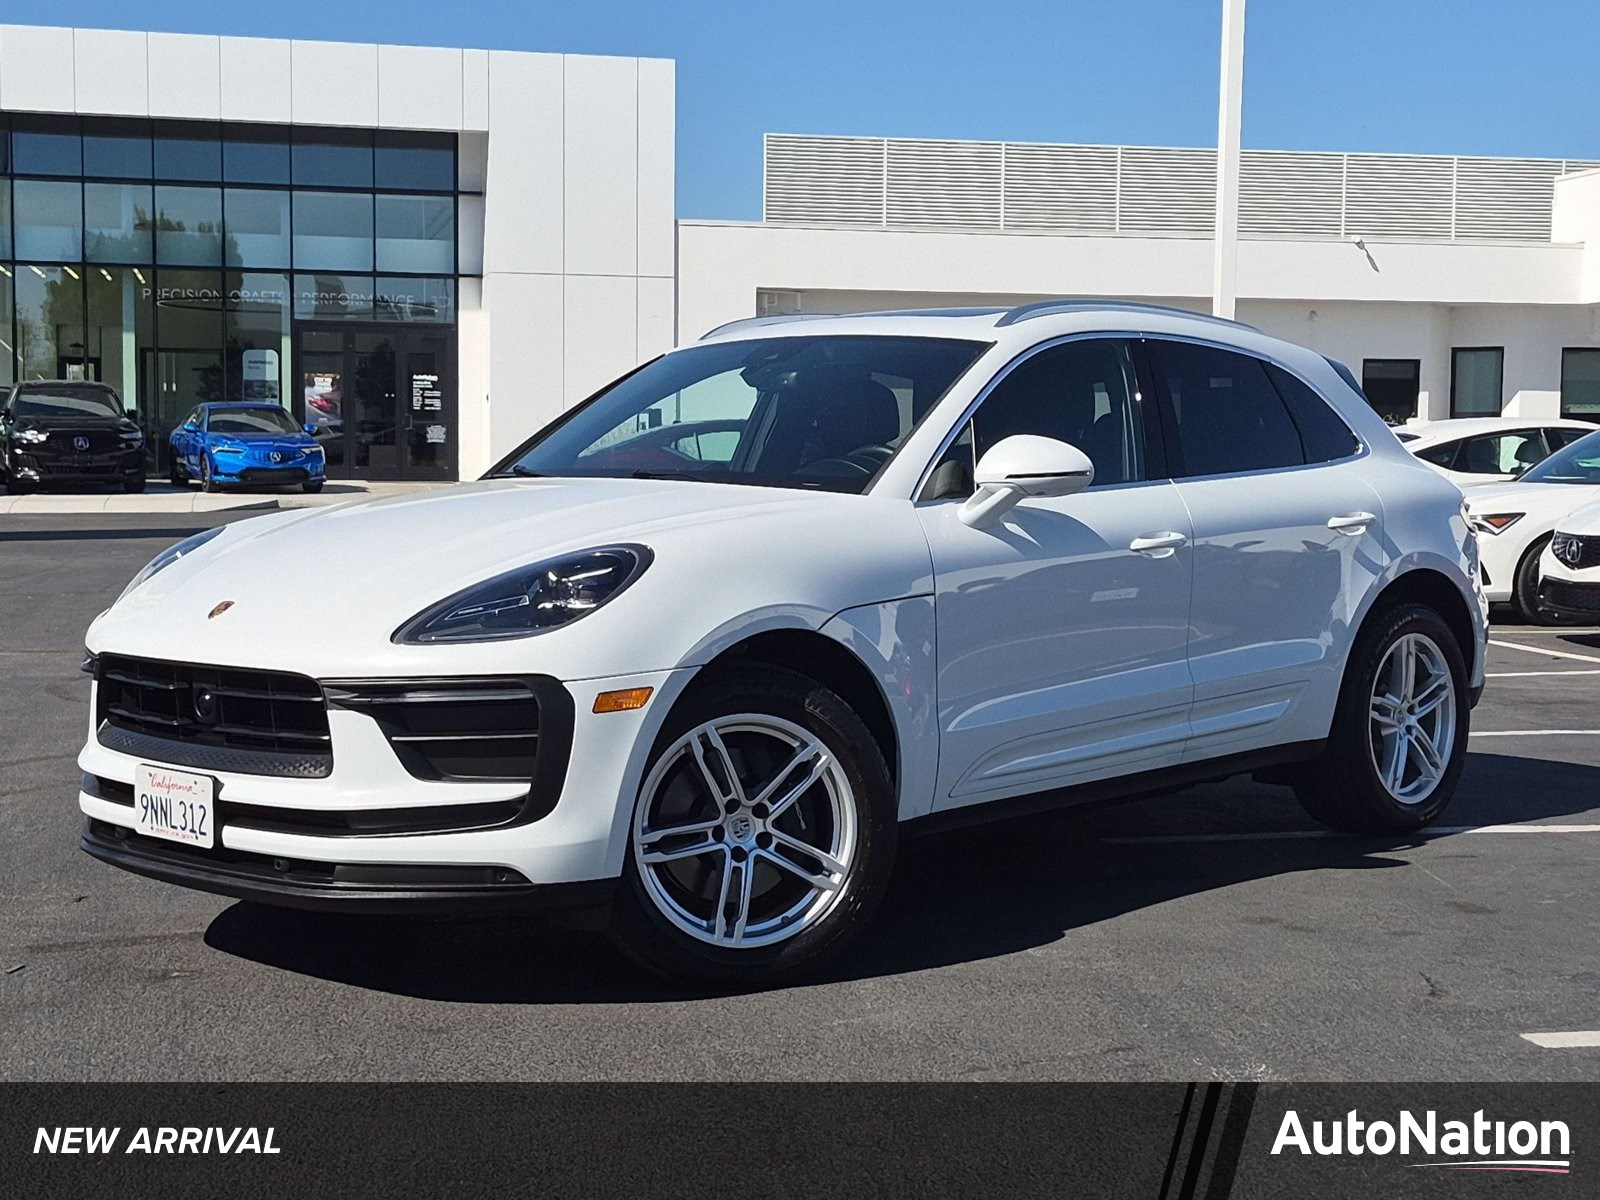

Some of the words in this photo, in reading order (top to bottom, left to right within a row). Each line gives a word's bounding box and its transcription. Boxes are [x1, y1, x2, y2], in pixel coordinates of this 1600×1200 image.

[142, 288, 224, 302] PRECISION
[229, 289, 296, 304] CRAFT
[302, 291, 415, 307] PERFORMANCE
[151, 773, 198, 795] California
[140, 793, 207, 837] 9NNL312
